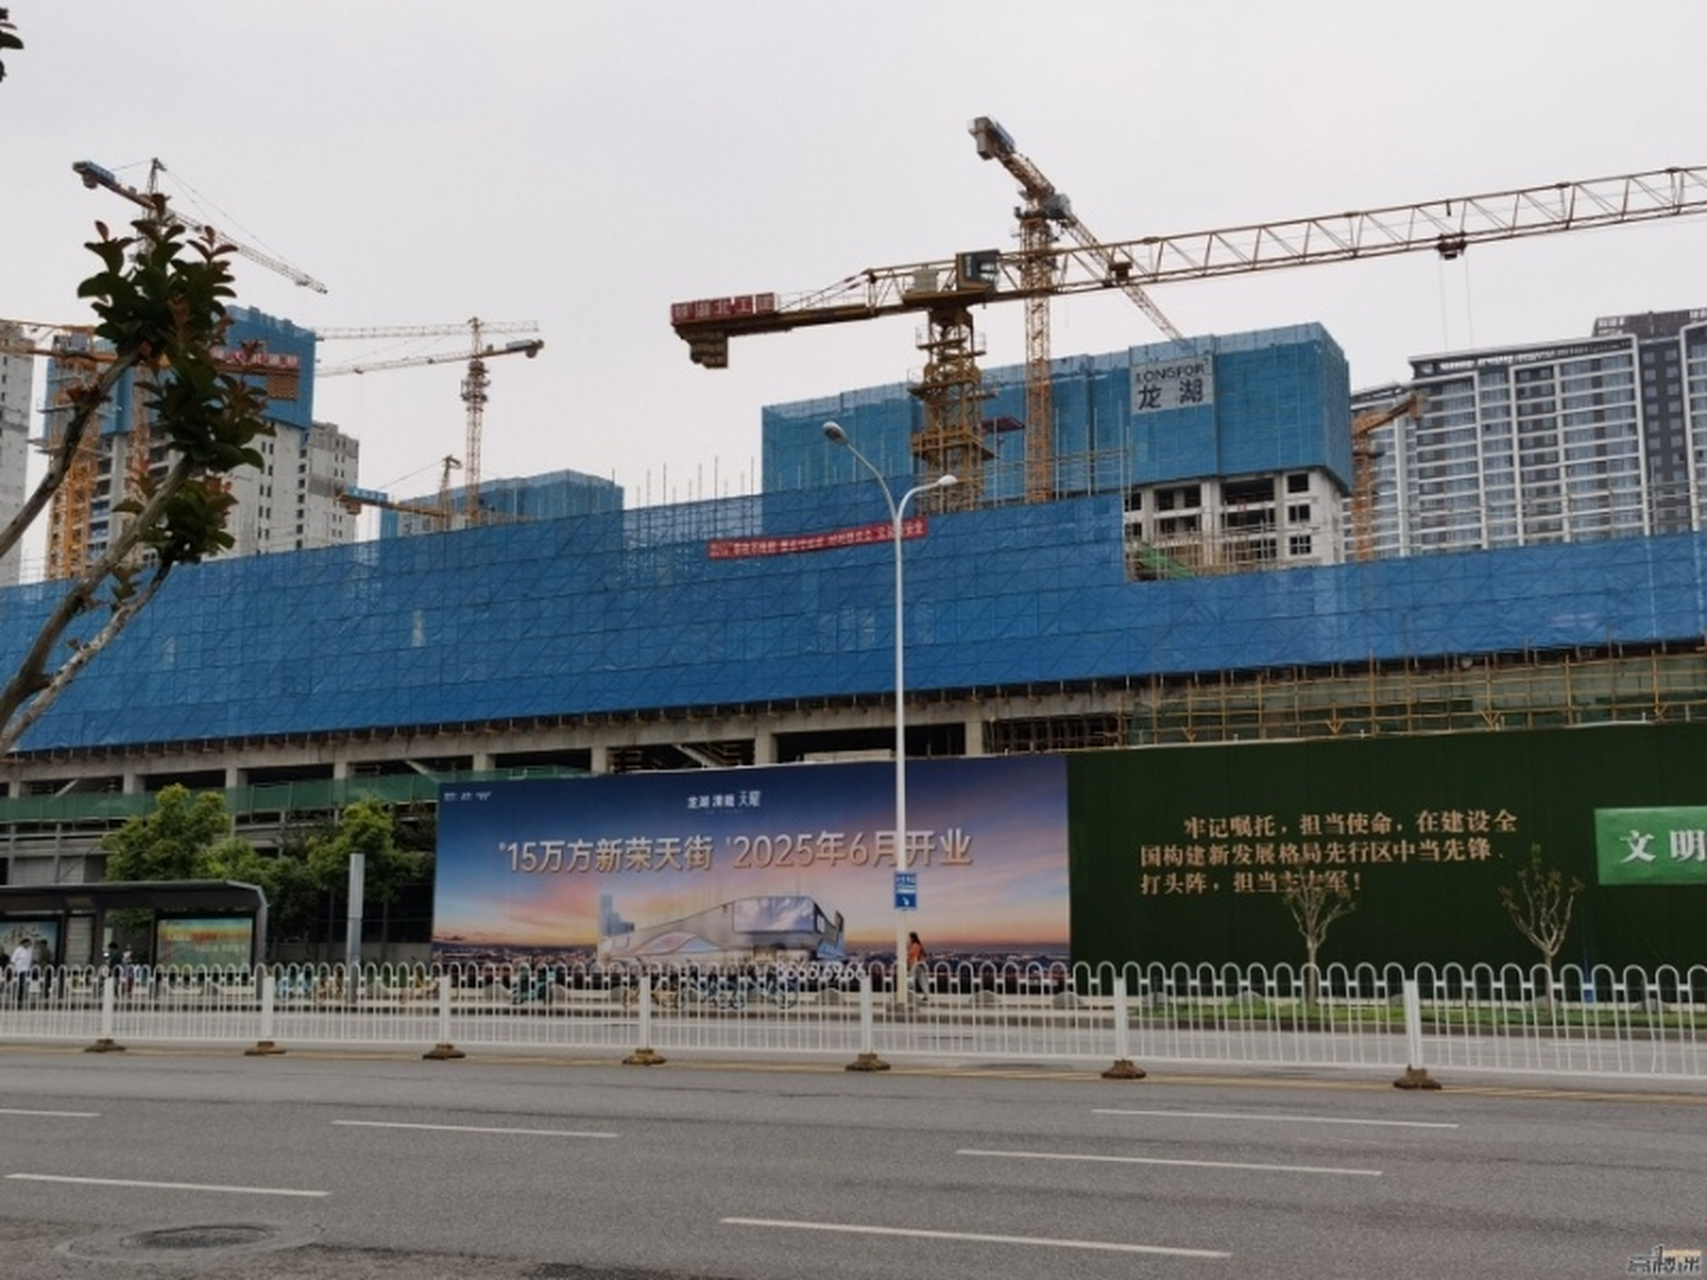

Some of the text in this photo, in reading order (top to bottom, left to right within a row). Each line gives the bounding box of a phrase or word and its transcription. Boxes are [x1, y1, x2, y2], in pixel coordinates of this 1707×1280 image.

[1135, 363, 1205, 383] LONGFOR
[1137, 378, 1203, 410] 龙湖
[1619, 829, 1706, 864] 文明
